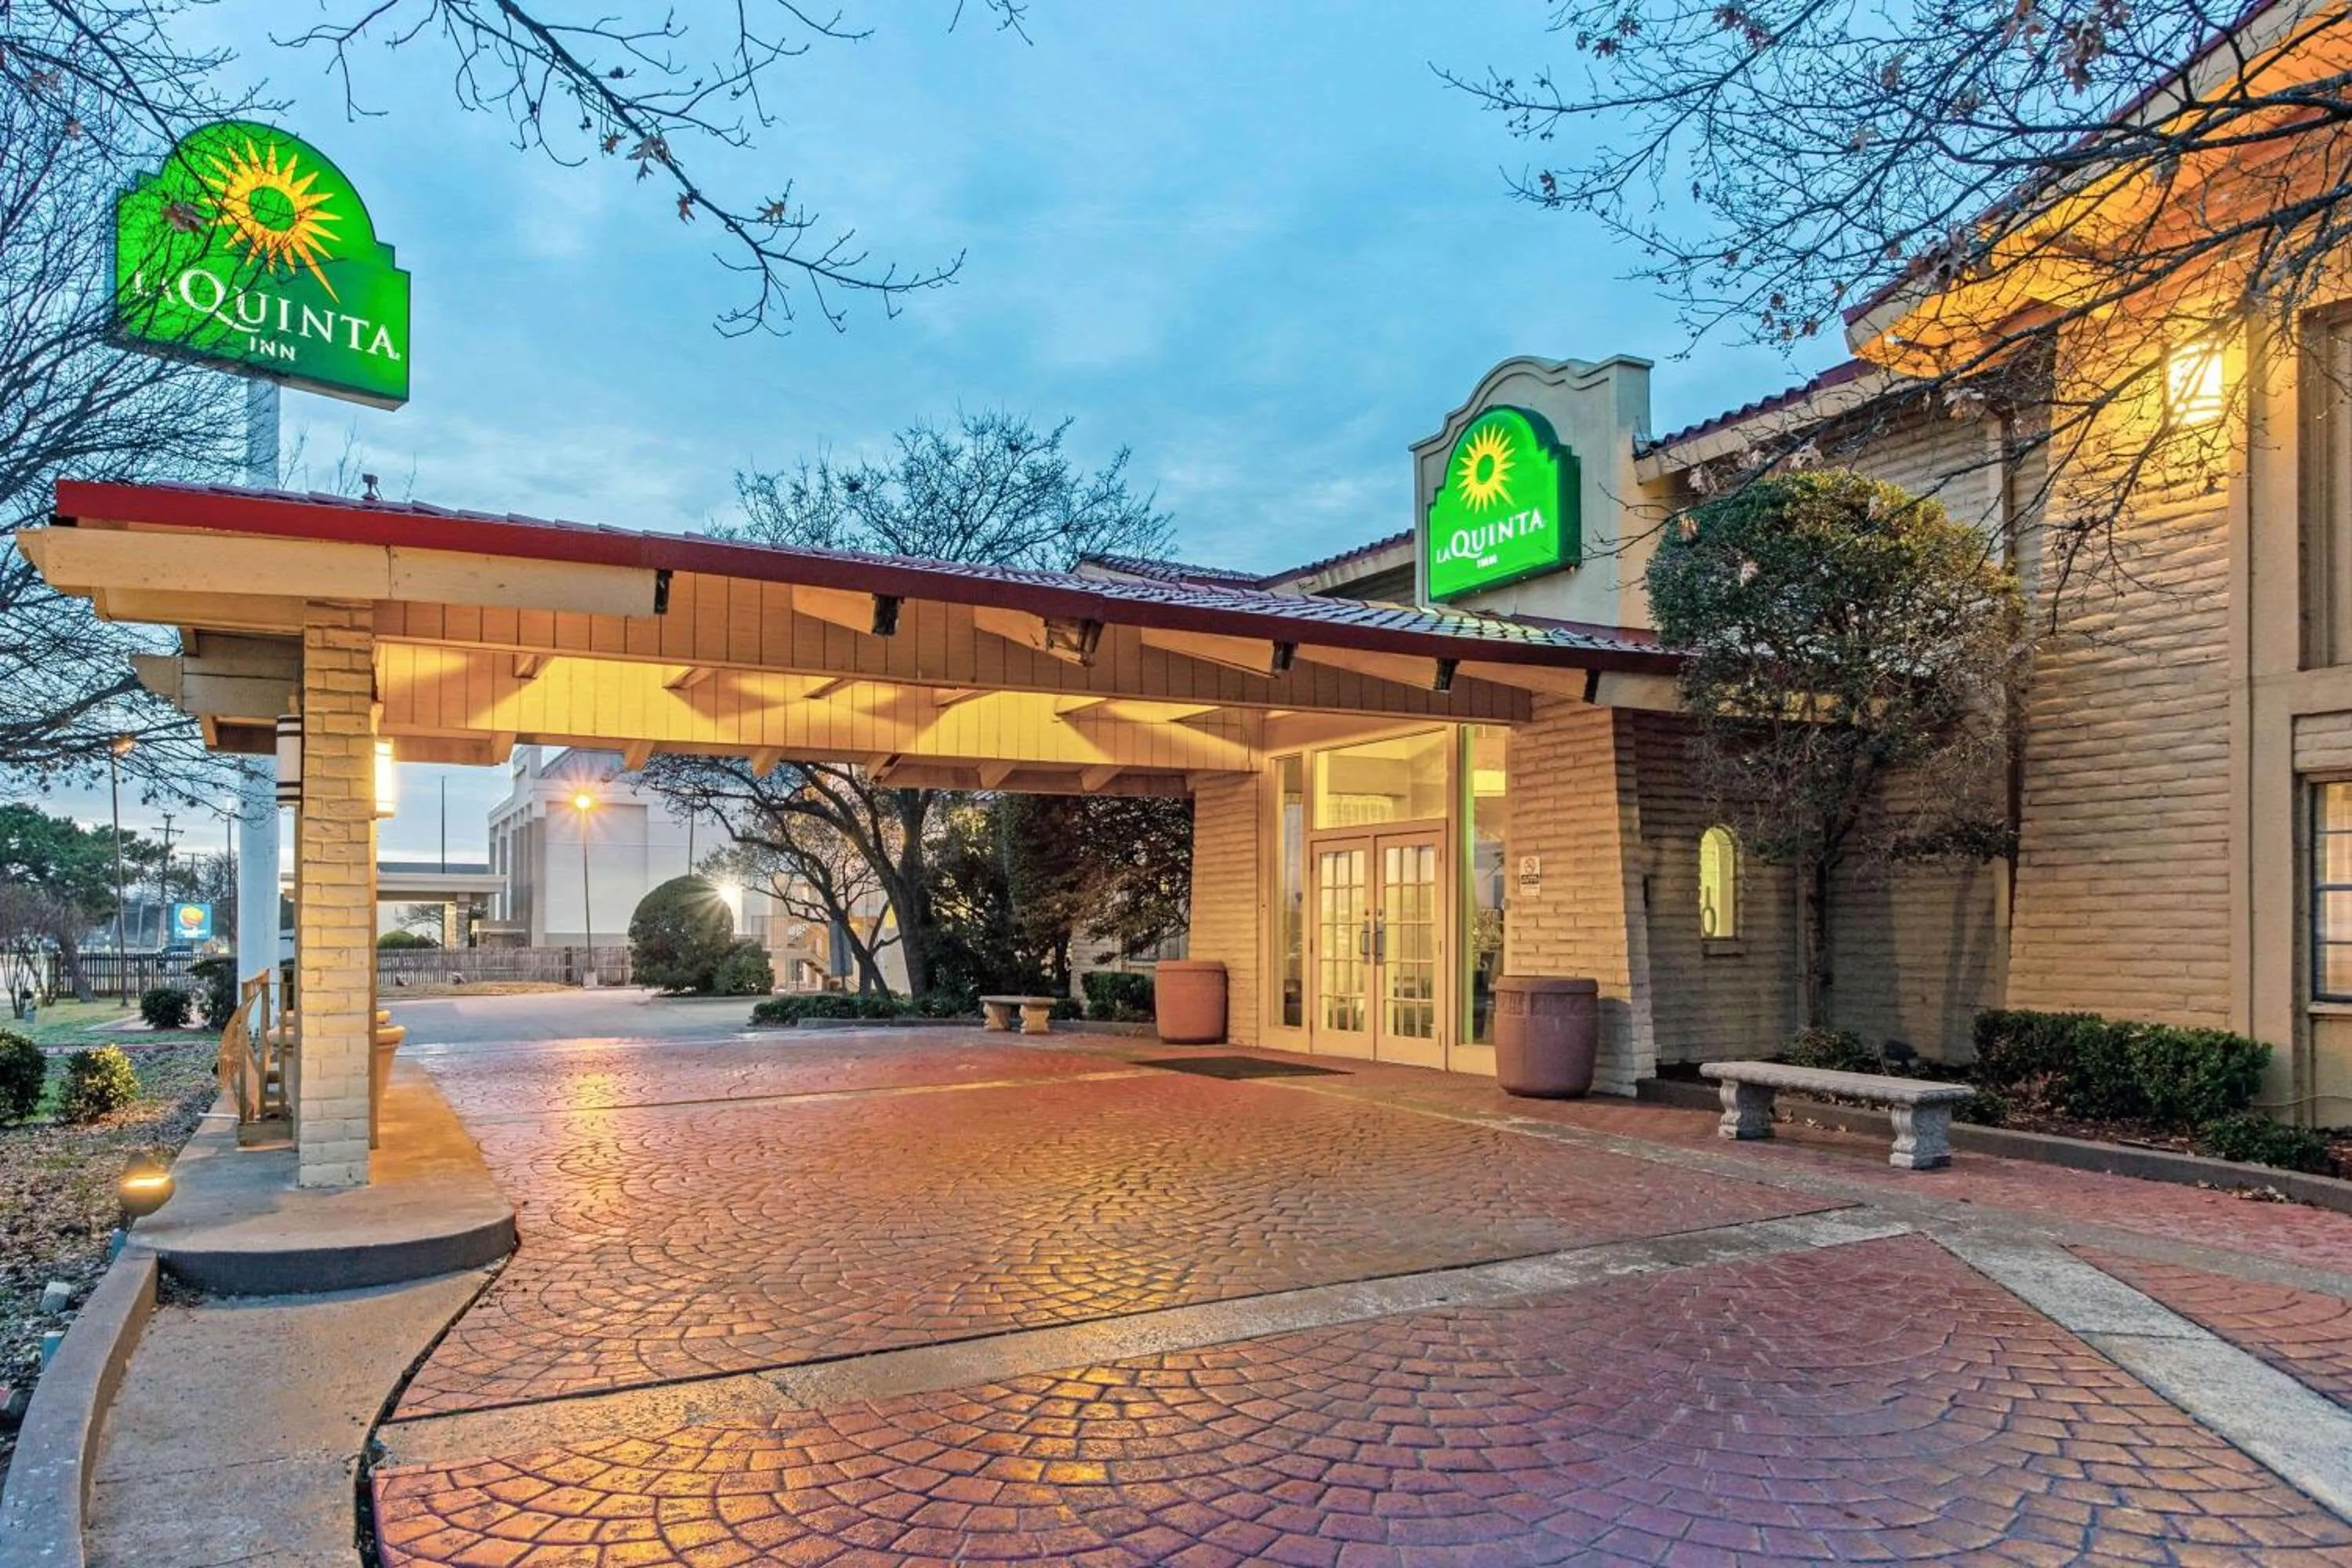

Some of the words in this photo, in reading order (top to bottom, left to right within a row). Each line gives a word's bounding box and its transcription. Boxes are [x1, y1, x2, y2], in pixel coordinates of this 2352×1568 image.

[178, 268, 401, 361] QUINTA
[249, 335, 296, 361] INN
[1436, 548, 1452, 564] LA
[1451, 506, 1548, 559] QUINTA
